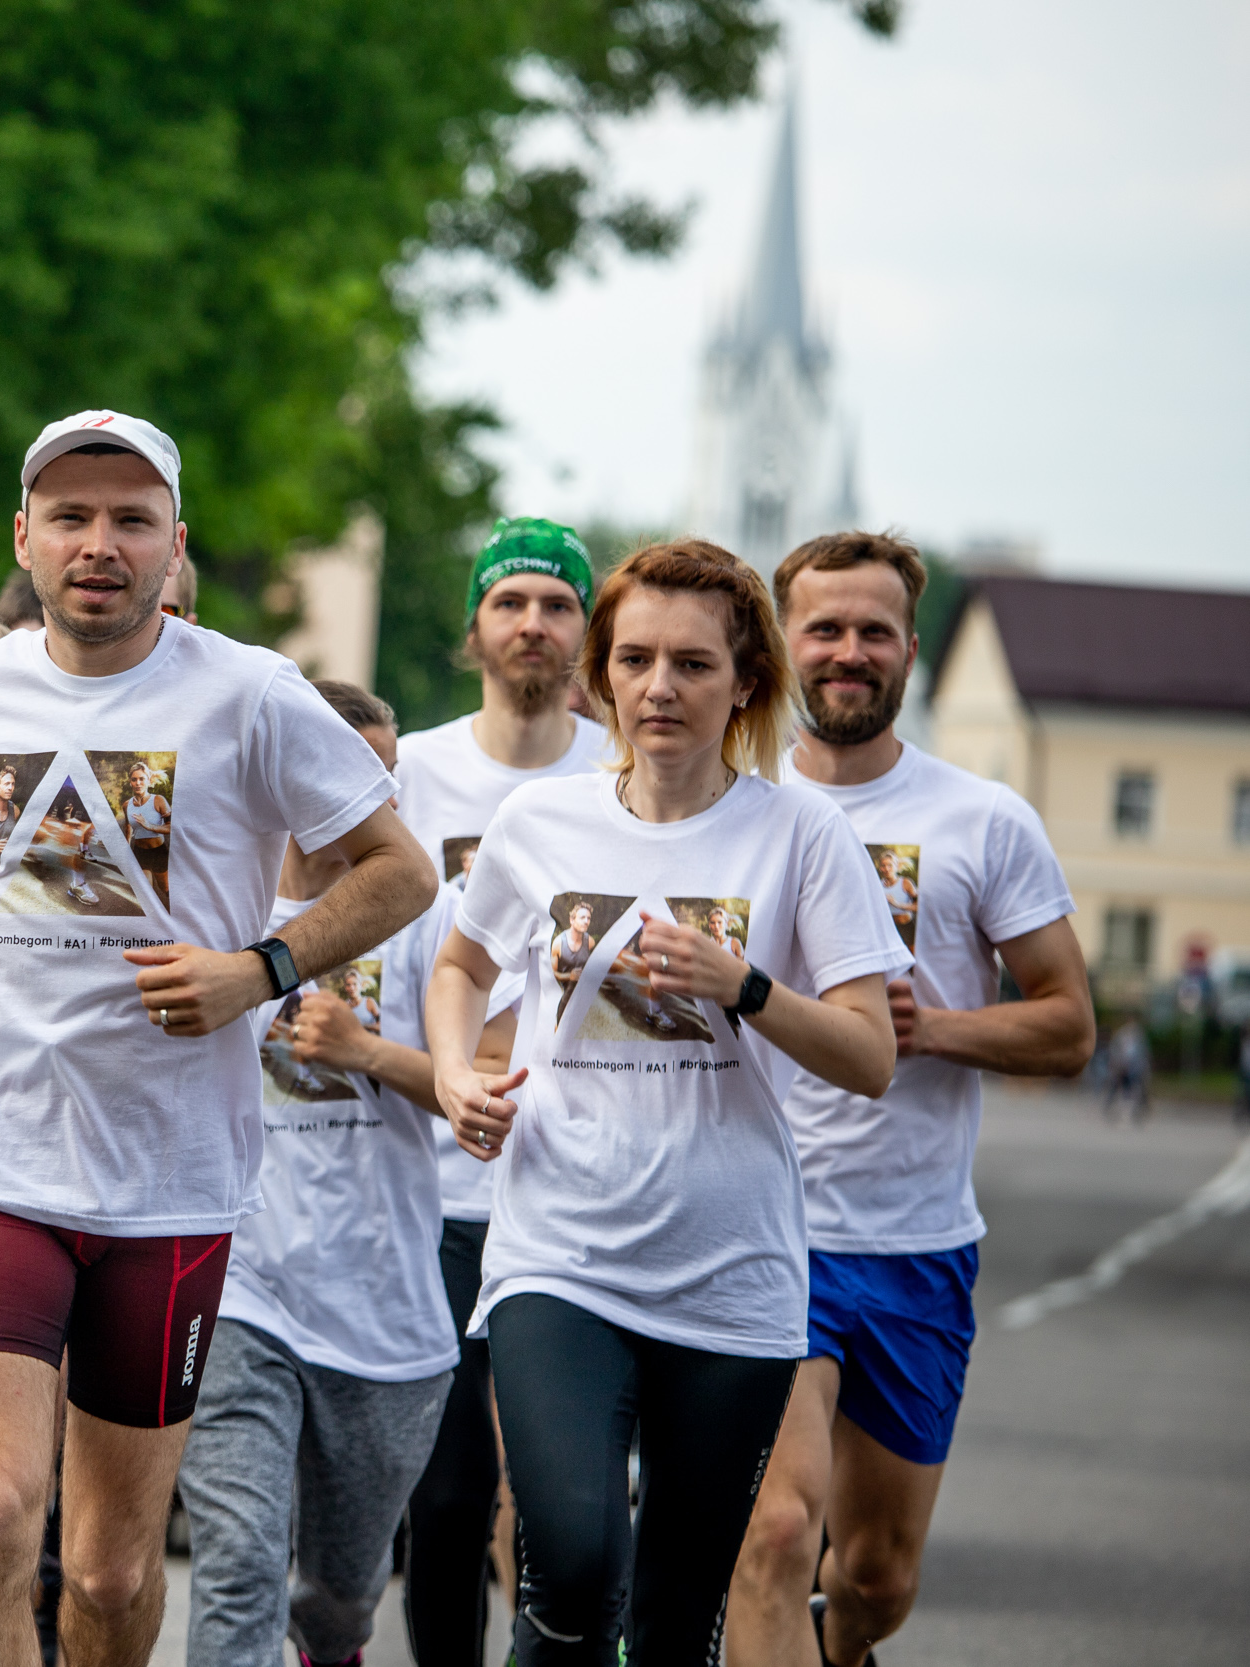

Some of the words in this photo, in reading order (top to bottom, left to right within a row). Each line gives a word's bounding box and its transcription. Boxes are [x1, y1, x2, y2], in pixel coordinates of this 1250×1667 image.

[64, 939, 87, 950] #A1
[99, 936, 175, 950] #brightteam
[552, 1058, 635, 1073] #velcombegom
[645, 1062, 668, 1074] #A1
[679, 1059, 740, 1072] #brighteam
